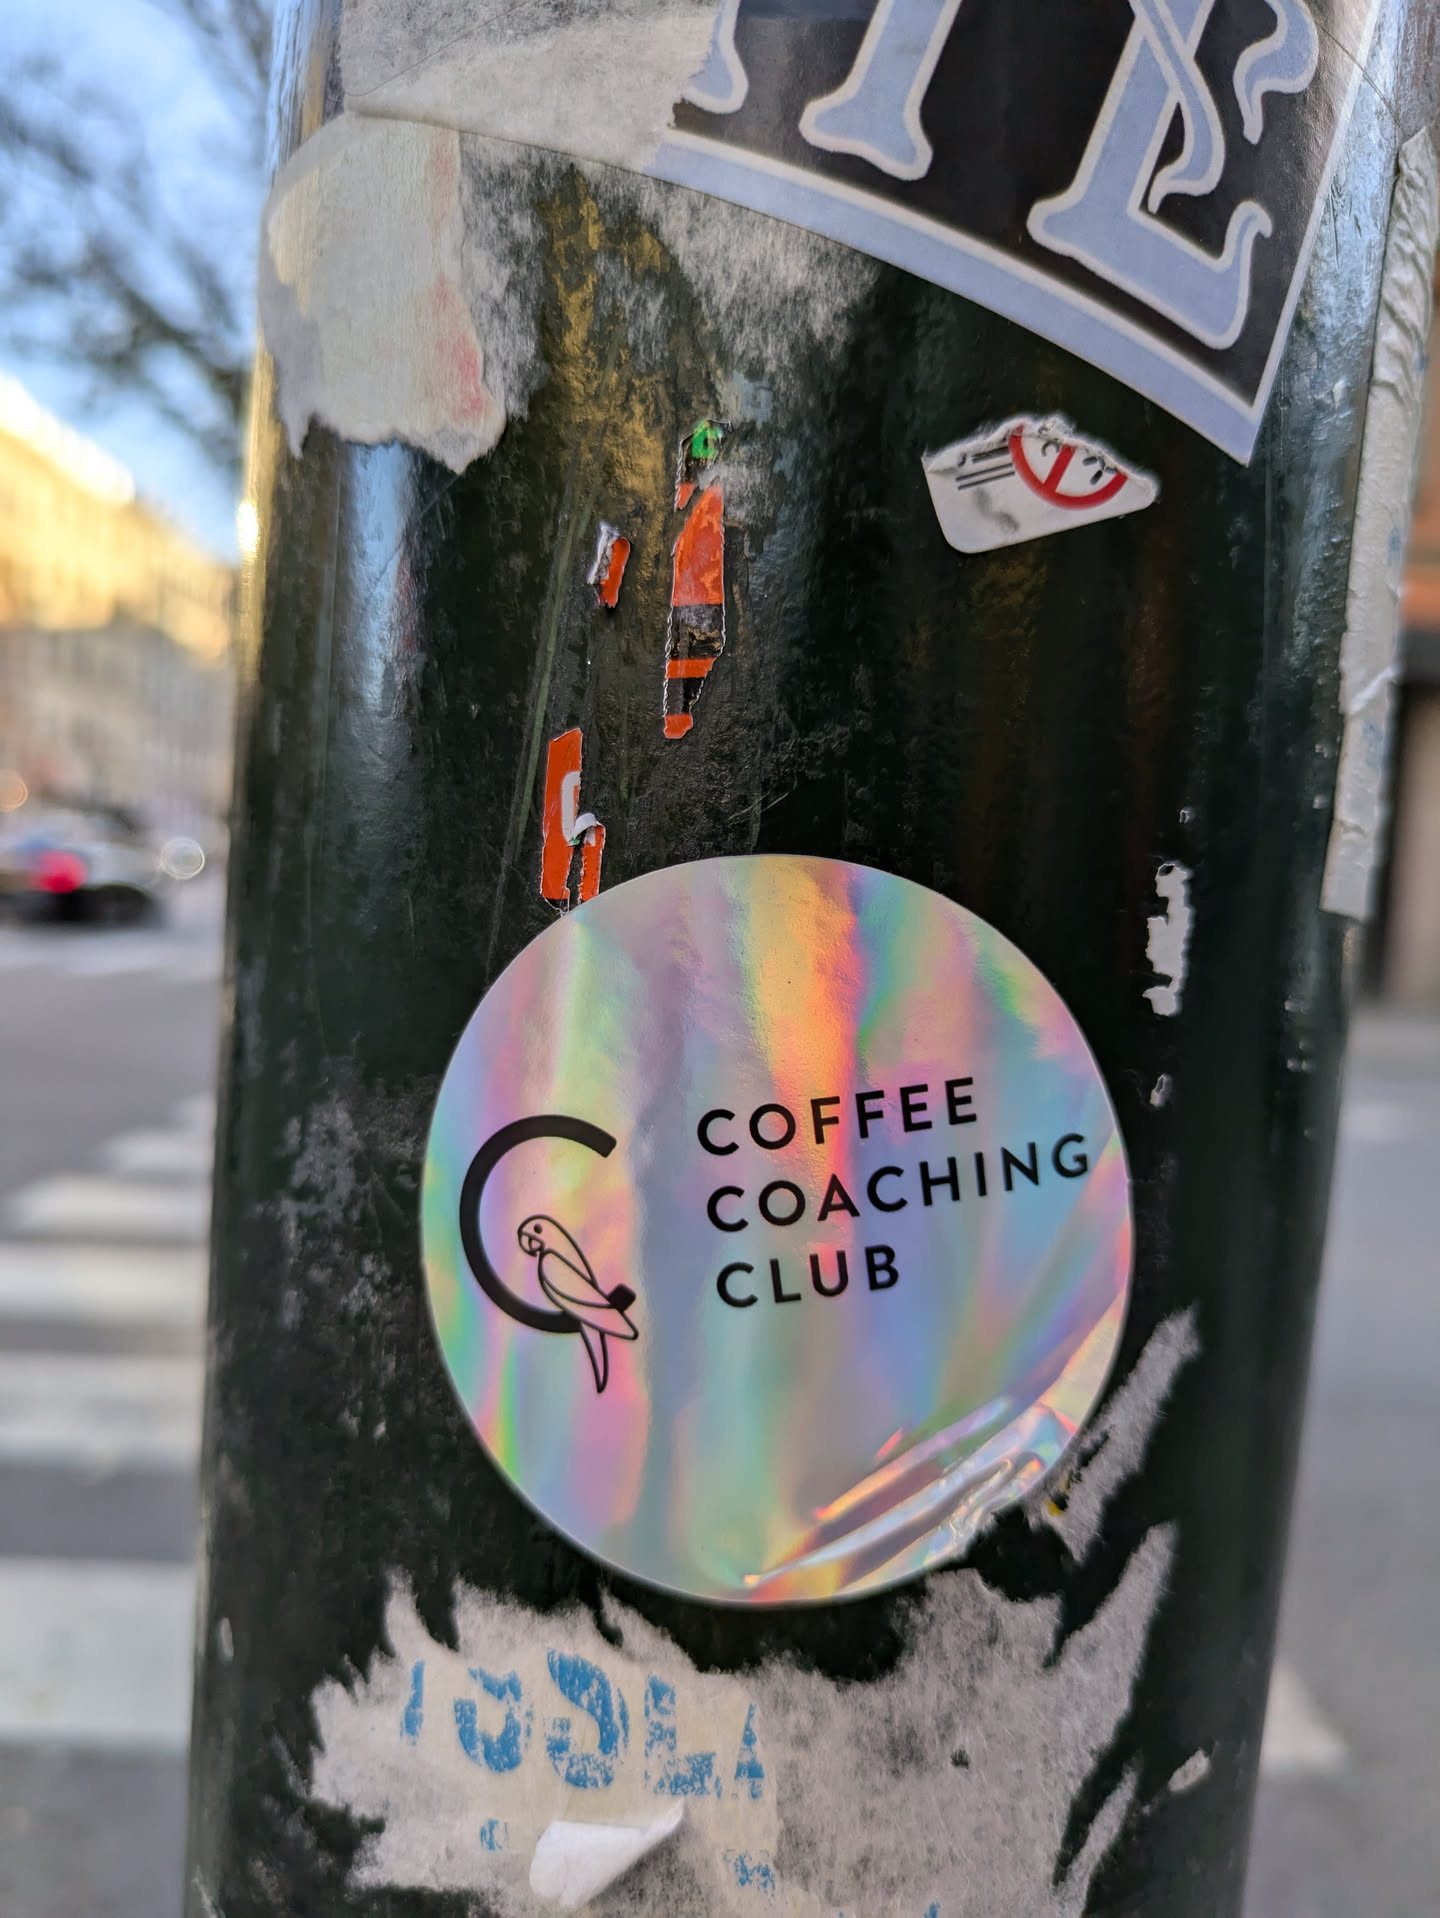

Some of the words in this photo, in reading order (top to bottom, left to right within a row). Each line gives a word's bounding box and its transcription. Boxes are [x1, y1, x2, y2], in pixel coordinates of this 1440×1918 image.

[696, 1076, 979, 1158] COFFEE
[705, 1132, 1090, 1234] COACHING
[715, 1243, 901, 1309] CLUB
